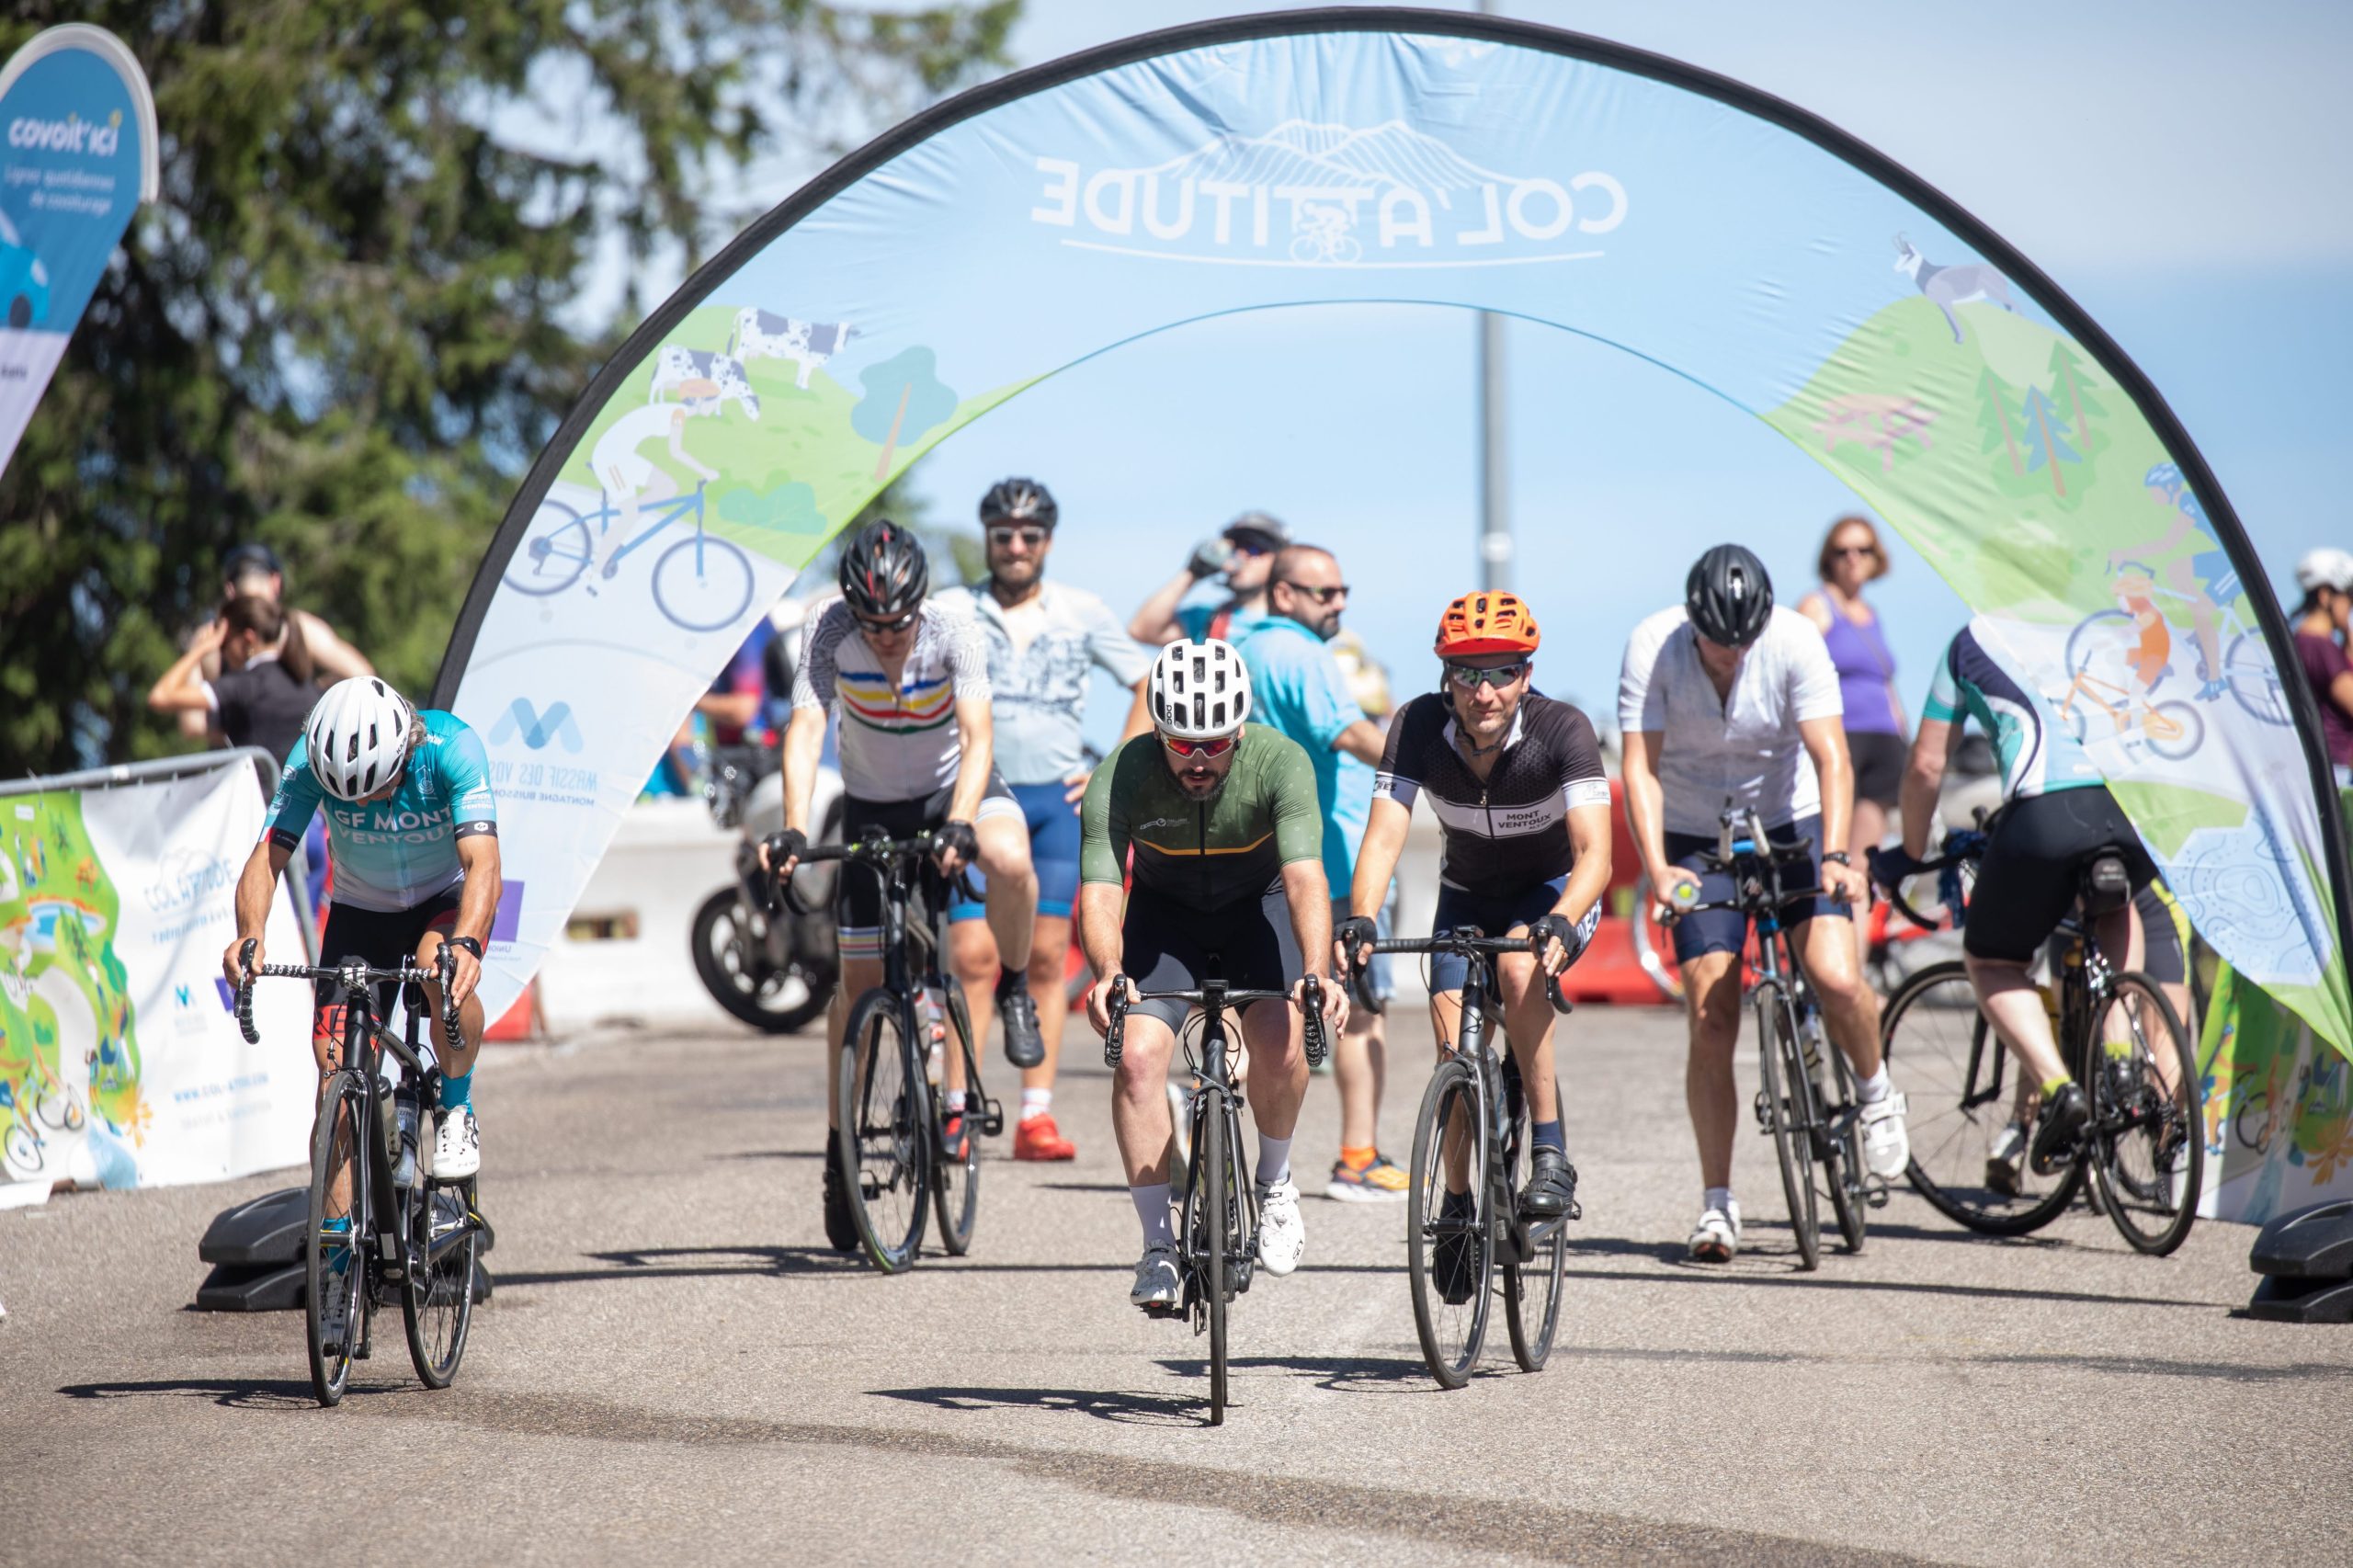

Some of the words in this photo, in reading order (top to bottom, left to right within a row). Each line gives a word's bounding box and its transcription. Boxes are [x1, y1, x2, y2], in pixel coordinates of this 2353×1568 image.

[335, 810, 366, 827] GF
[1498, 813, 1551, 828] VENTOUX
[1506, 810, 1540, 821] MONT
